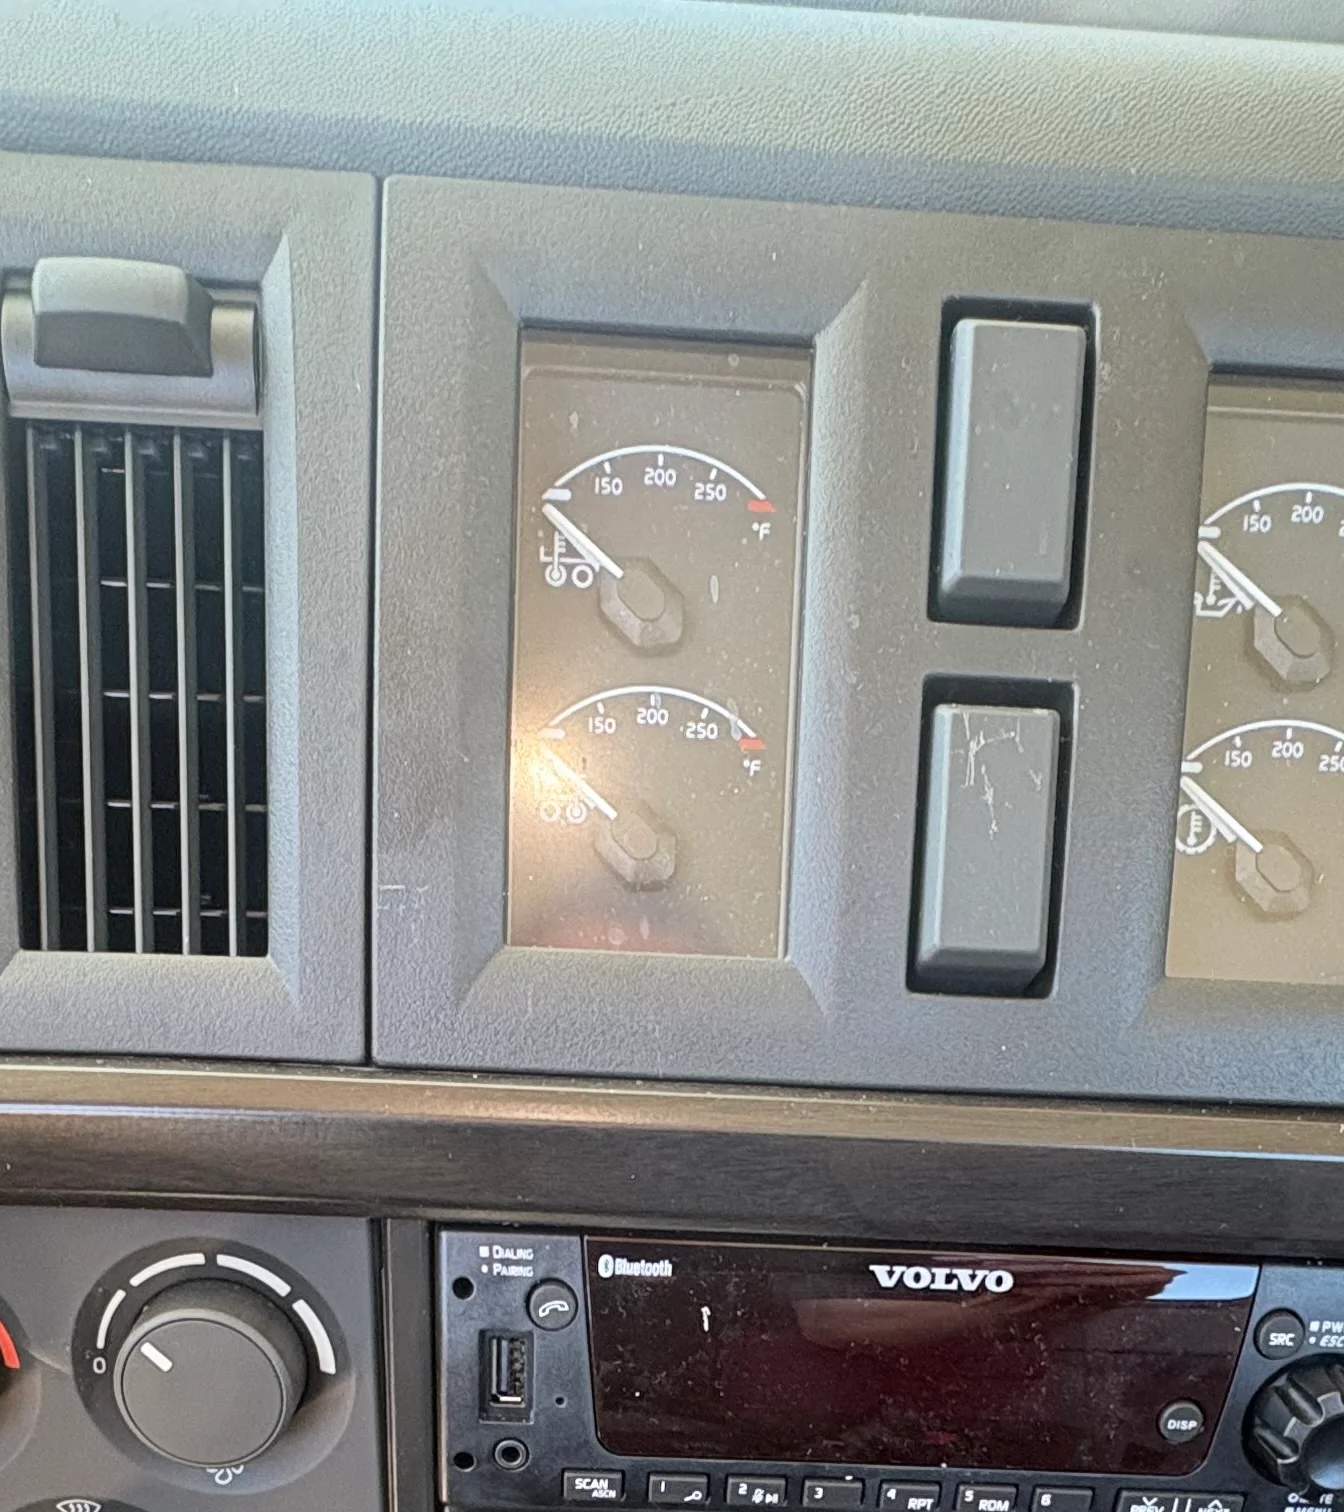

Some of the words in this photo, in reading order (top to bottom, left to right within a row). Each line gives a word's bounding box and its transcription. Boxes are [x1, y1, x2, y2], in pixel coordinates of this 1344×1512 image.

[594, 476, 623, 496] 150
[644, 467, 677, 487] 200
[694, 482, 727, 502] 250
[1290, 504, 1324, 524] 200
[1242, 514, 1272, 533] 150
[588, 716, 617, 734] 150
[636, 707, 669, 726] 200
[685, 721, 719, 740] 250
[1271, 740, 1305, 759] 200
[1224, 750, 1253, 768] 150
[614, 1258, 673, 1277] Bluetooth
[868, 1264, 1014, 1293] VOLVO
[1268, 1332, 1296, 1347] SRC
[1167, 1418, 1198, 1431] DISP
[574, 1477, 609, 1490] SCAN
[738, 1483, 748, 1495] 2
[814, 1487, 824, 1499] 3
[886, 1488, 897, 1500] 4
[964, 1490, 974, 1502] 5
[1040, 1494, 1052, 1507] 6
[907, 1497, 934, 1512] RPT
